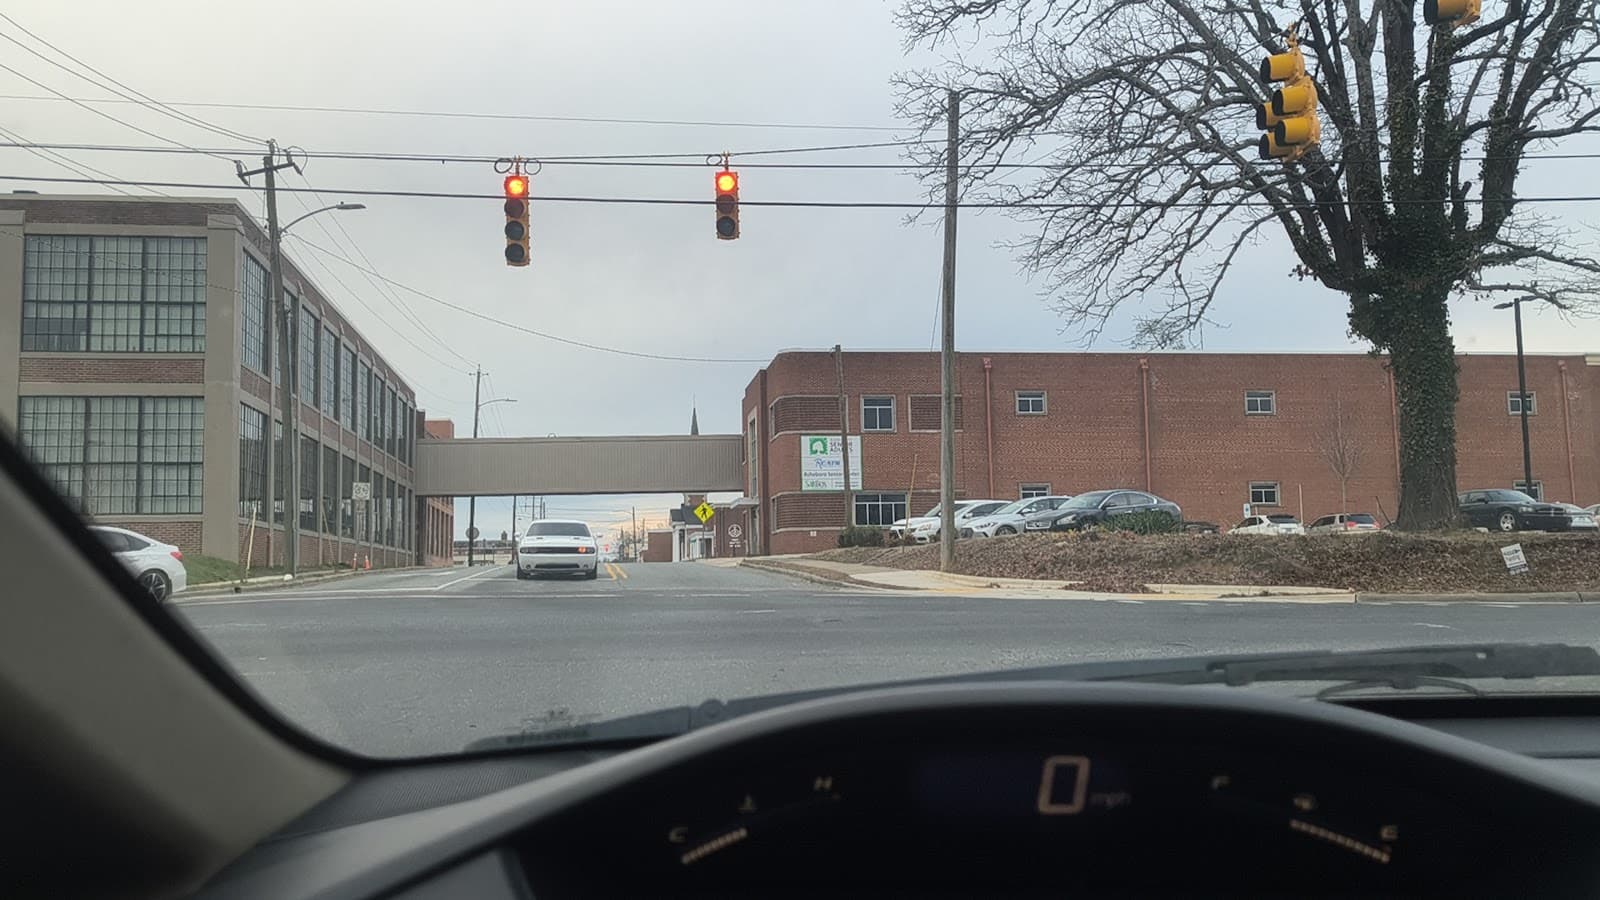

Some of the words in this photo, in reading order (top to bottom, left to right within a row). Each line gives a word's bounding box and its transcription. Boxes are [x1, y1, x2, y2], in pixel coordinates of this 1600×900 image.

[814, 776, 833, 792] H
[1038, 755, 1091, 815] 0
[1090, 790, 1132, 810] mph
[1210, 776, 1231, 791] F
[669, 826, 689, 843] C
[1379, 825, 1398, 841] E
